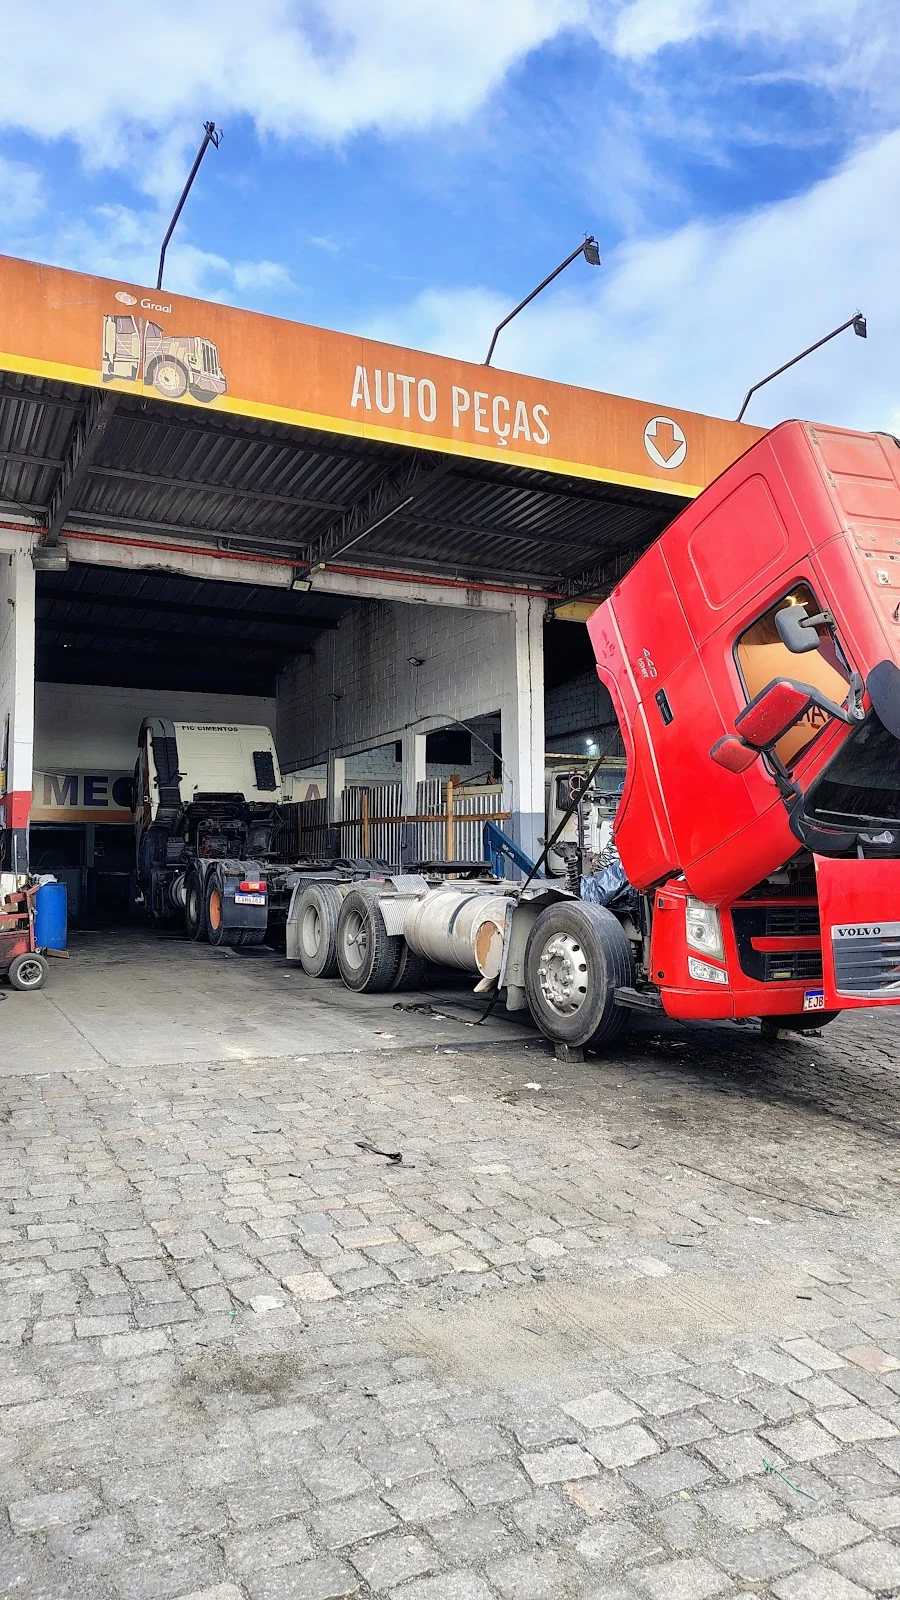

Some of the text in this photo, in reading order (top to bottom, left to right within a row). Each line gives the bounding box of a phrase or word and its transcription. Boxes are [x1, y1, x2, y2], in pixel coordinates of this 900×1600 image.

[141, 298, 172, 313] Graal
[350, 364, 550, 446] AUTO PEÇAS
[837, 927, 881, 937] VOLVO
